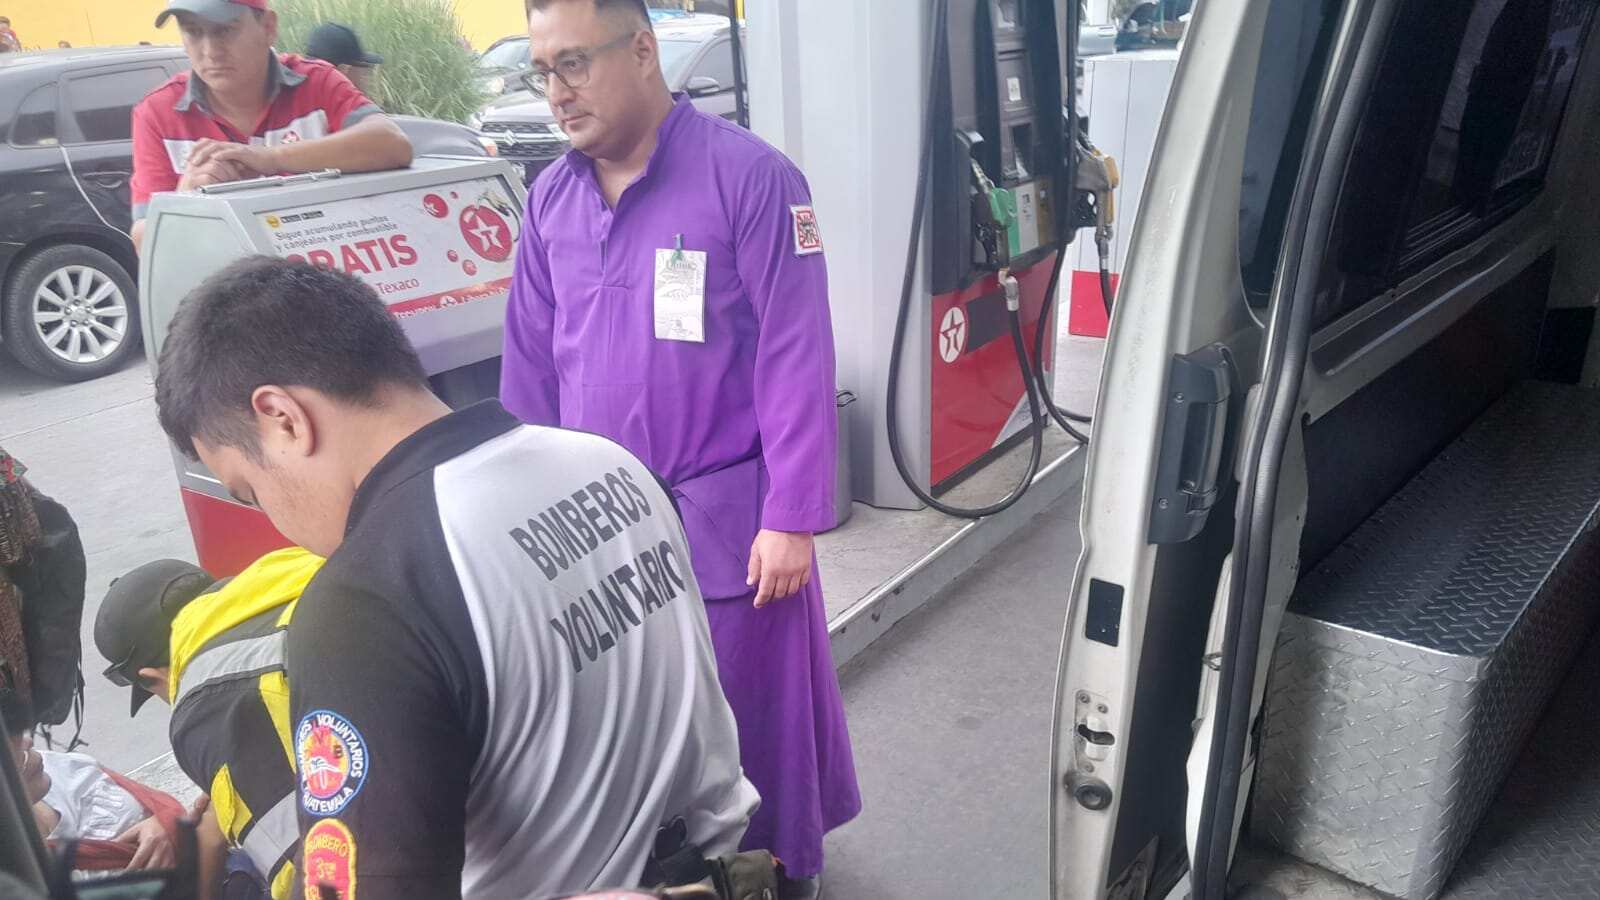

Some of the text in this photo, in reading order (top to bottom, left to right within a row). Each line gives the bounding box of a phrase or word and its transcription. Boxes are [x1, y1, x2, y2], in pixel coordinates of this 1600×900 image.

[286, 234, 418, 276] RATIS
[377, 278, 420, 295] Texaco
[508, 466, 652, 581] BOMBEROS
[316, 713, 364, 779] VOLUNTARIOS
